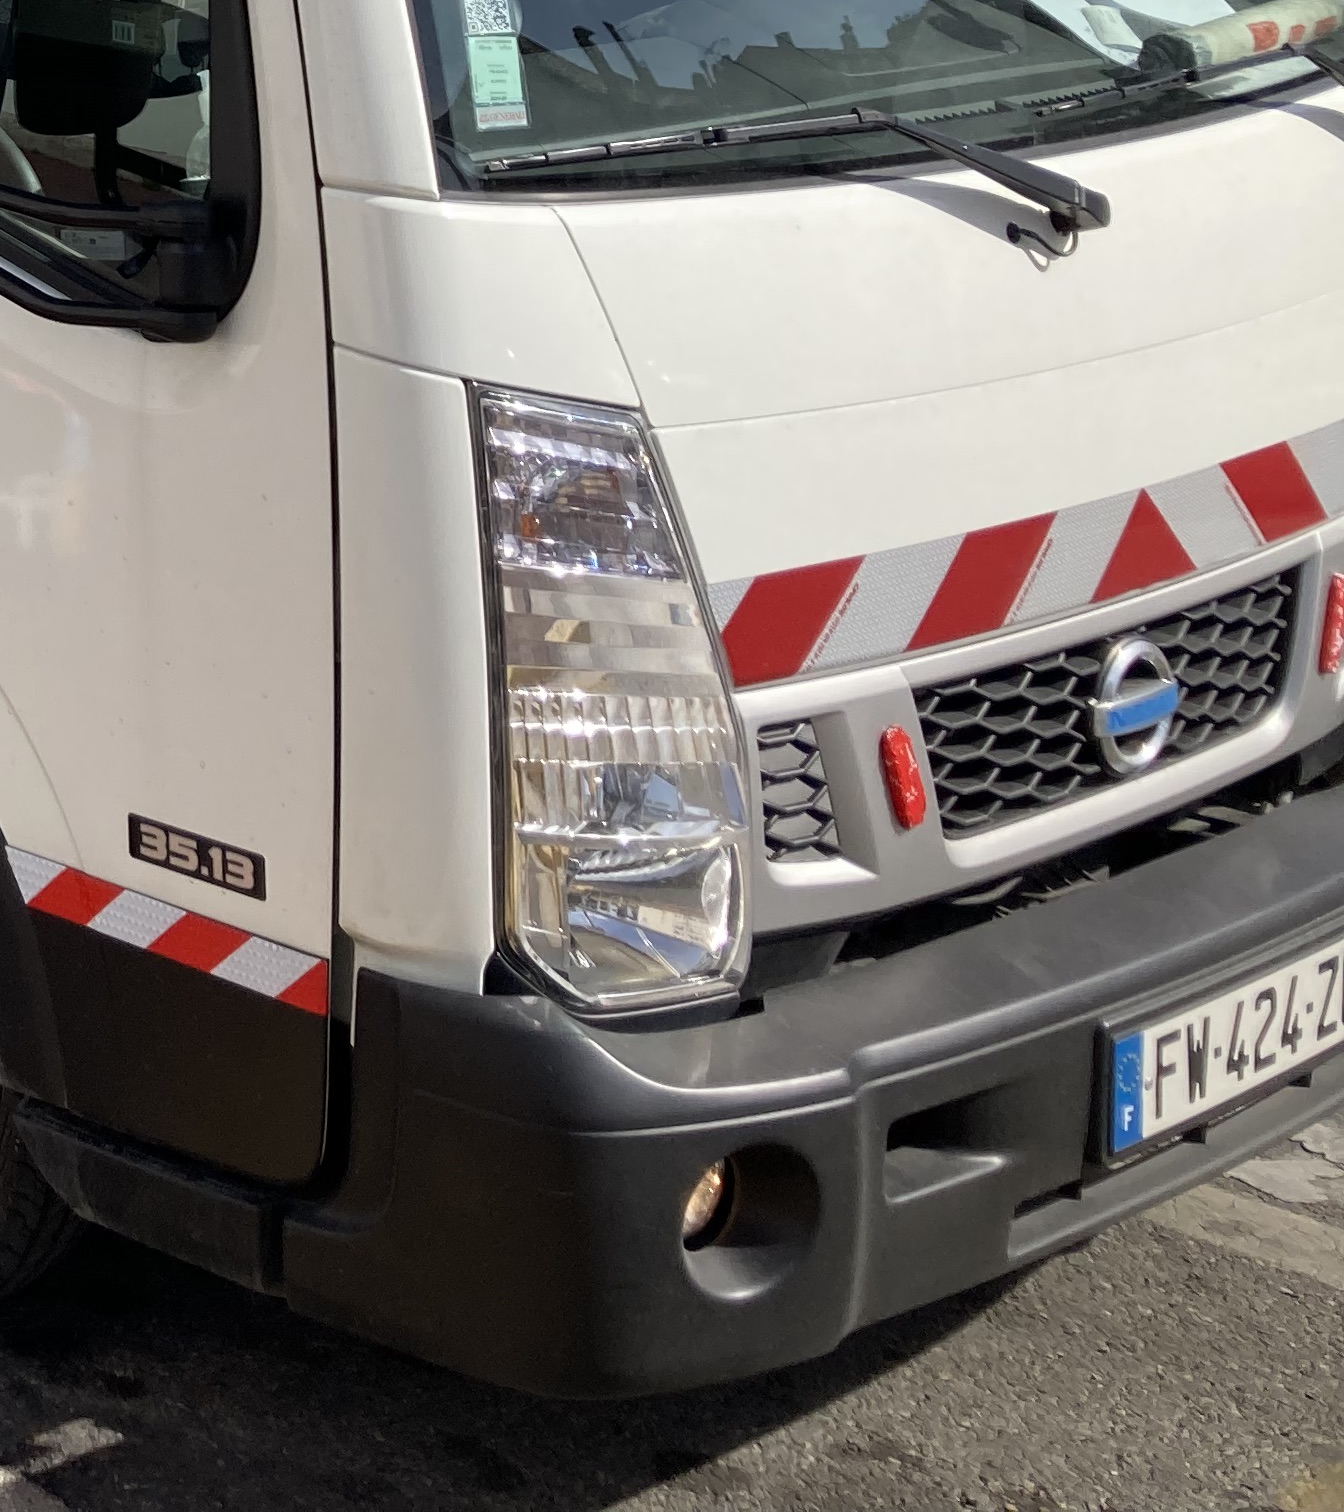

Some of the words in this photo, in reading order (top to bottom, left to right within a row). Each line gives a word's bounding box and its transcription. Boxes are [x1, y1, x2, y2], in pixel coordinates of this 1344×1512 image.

[139, 823, 256, 890] 35.13
[1155, 955, 1344, 1120] FW-424-Z
[1122, 1105, 1135, 1132] F
